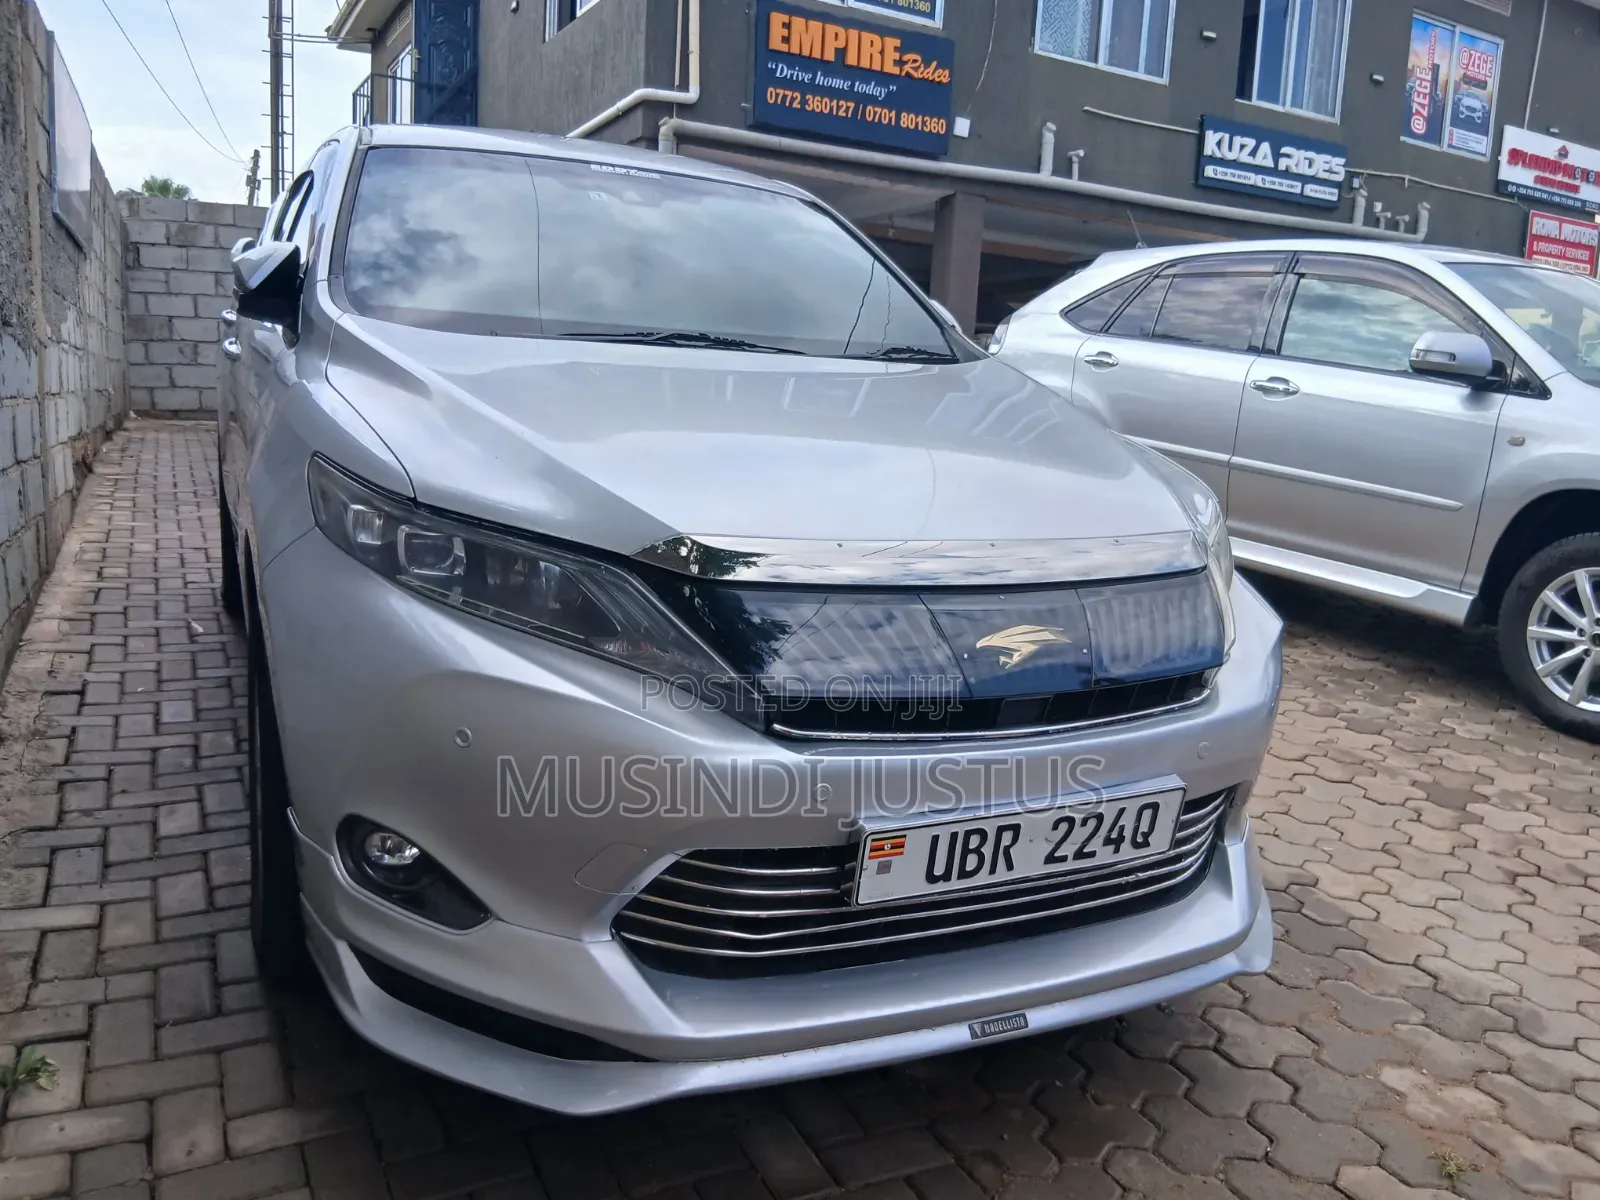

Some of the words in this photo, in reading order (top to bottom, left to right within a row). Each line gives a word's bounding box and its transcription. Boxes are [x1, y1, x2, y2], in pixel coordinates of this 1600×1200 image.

[769, 12, 902, 75] EMPIRE
[901, 53, 951, 84] Rides
[1428, 30, 1437, 69] MOTORS
[1460, 48, 1495, 78] @ZEGE
[815, 71, 851, 91] home
[1466, 70, 1486, 81] MOTORS
[766, 87, 801, 109] 0772
[805, 94, 855, 118] 360127
[857, 103, 863, 120] /
[865, 105, 897, 126] 0701
[900, 112, 947, 135] 801360
[1411, 66, 1432, 135] @ZEGE
[1203, 130, 1274, 168] KUZA
[1278, 146, 1346, 182] RIDES
[1538, 242, 1565, 256] PROPERTY
[1565, 247, 1590, 261] SERVICES
[1560, 223, 1598, 246] MOTORS
[925, 823, 1022, 884] UBR
[1043, 801, 1160, 865] 224Q
